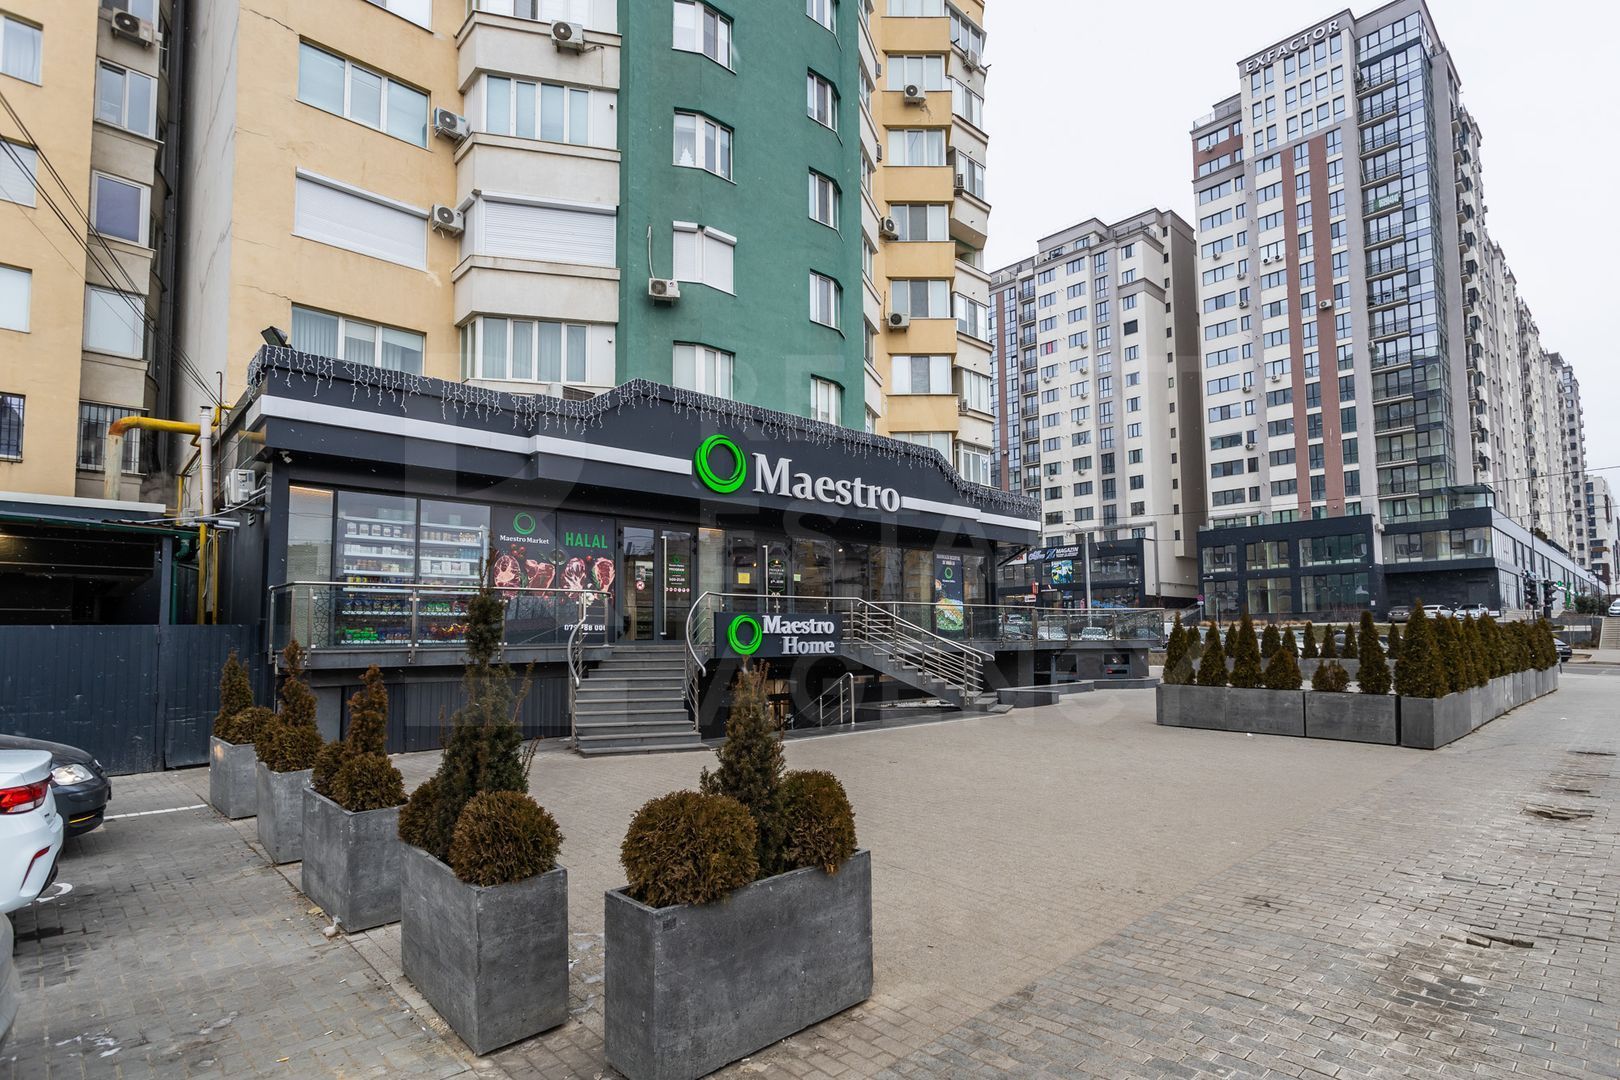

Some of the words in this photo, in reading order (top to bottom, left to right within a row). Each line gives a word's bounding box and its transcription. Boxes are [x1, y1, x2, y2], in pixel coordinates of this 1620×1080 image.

[1245, 20, 1340, 73] EXFACTOR
[752, 453, 902, 513] Maestro
[500, 535, 526, 543] Maestro
[527, 536, 550, 545] Market
[565, 532, 608, 549] HALAL
[762, 615, 835, 635] Maestro
[782, 636, 835, 655] Home
